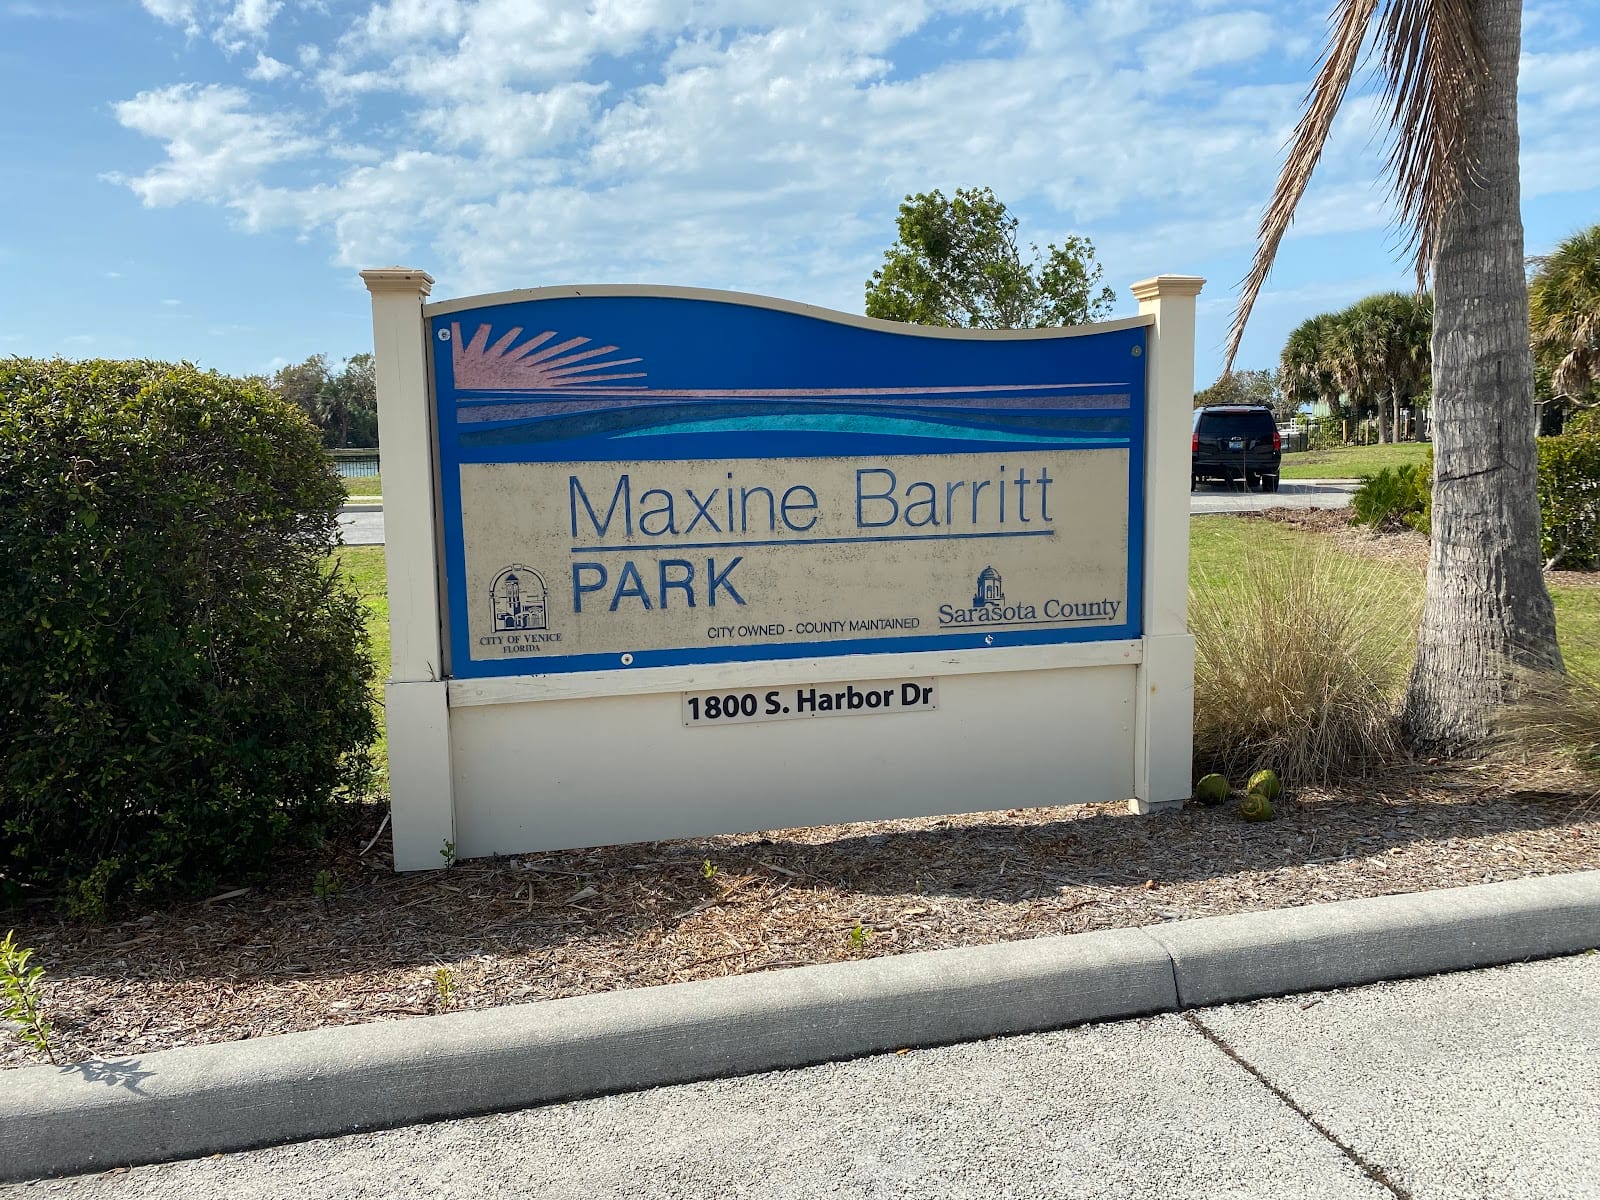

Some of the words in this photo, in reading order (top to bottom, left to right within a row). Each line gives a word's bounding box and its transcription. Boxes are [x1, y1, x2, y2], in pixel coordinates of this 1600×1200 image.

[569, 472, 818, 537] Maxine
[856, 465, 1053, 528] Barritt
[572, 556, 747, 613] PARK
[938, 601, 1036, 625] Sarasota
[1043, 597, 1121, 621] County
[480, 636, 504, 645] CITY
[508, 635, 520, 644] OF
[524, 633, 562, 642] VENICE
[707, 626, 734, 639] CITY
[738, 624, 785, 637] OWNED
[796, 620, 846, 634] COUNTY
[850, 617, 920, 631] MAINTAINED
[503, 645, 540, 653] FLORIDA
[688, 693, 757, 720] 1800
[765, 691, 790, 715] S.
[797, 685, 894, 712] Harbor
[901, 683, 933, 706] Dr
